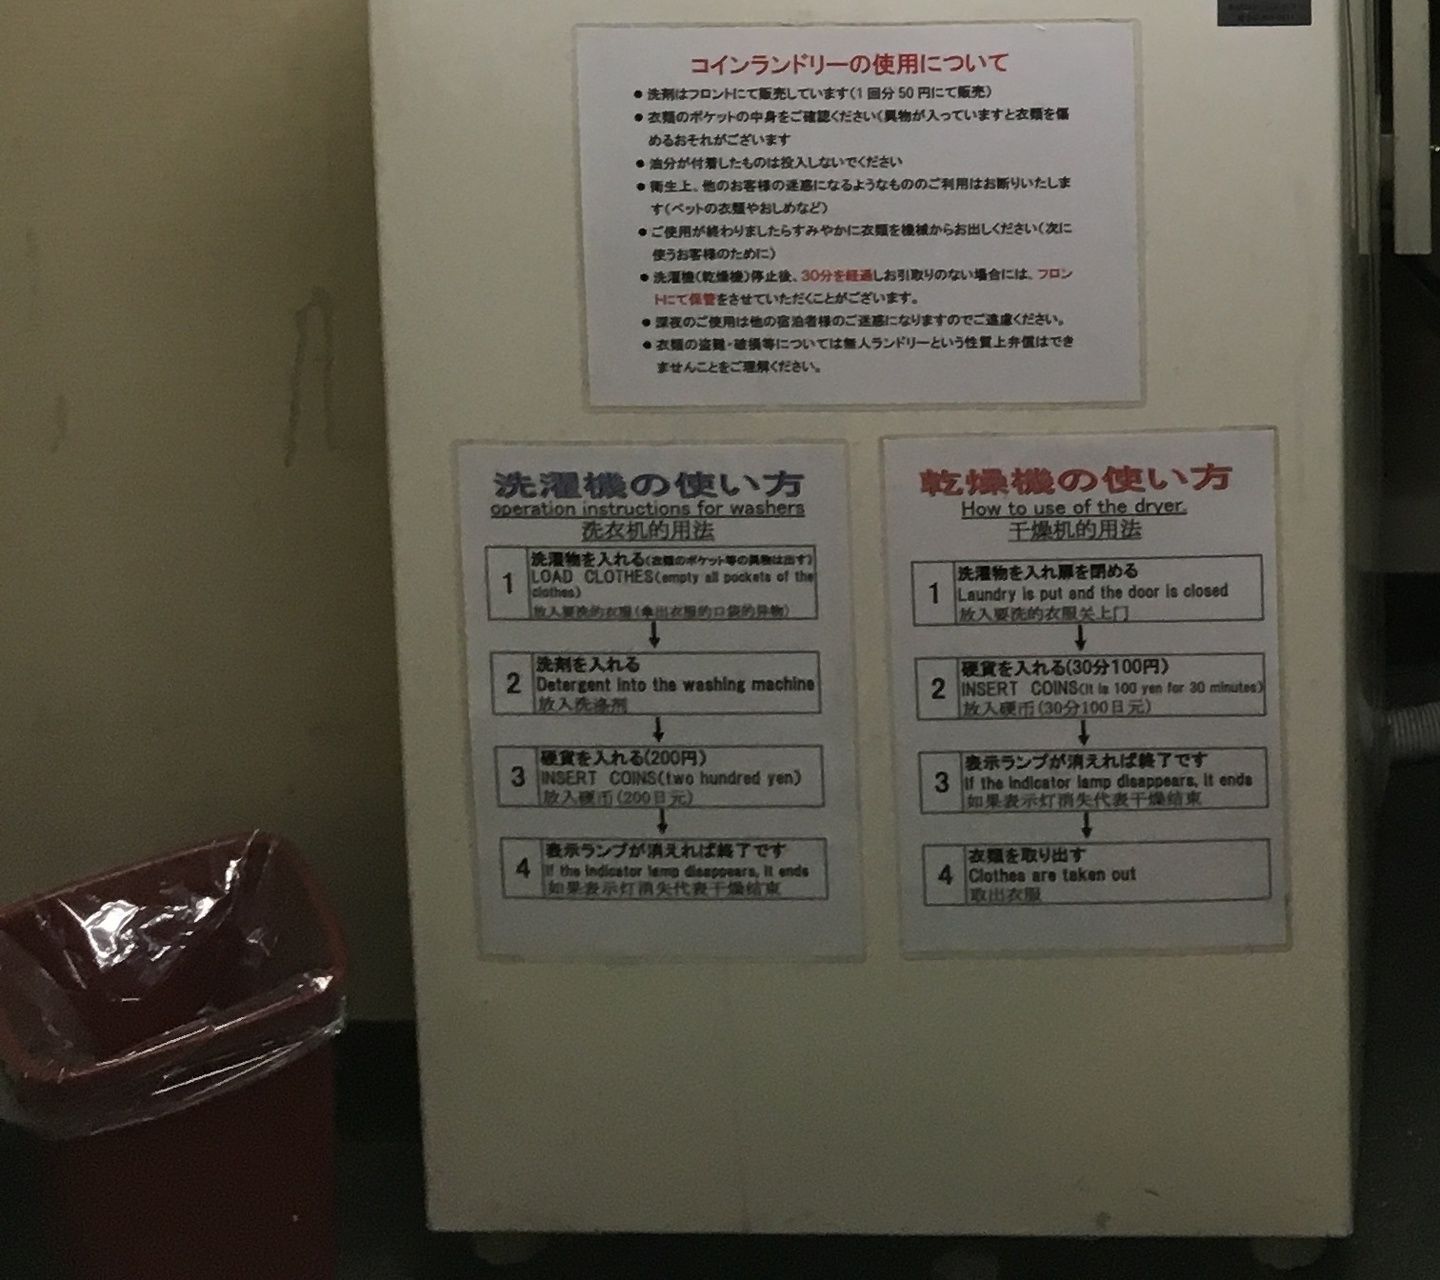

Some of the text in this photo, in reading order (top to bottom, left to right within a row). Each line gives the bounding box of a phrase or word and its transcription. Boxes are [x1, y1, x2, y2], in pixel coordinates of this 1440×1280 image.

[691, 52, 1010, 75] コインランドリーの使用について
[648, 132, 791, 148] めるおそれがございます
[649, 156, 903, 170] 油分が付着したものは投入しないでください
[493, 471, 805, 498] 洗濯機の使い方
[920, 463, 1233, 497] 乾燥機の使い方
[491, 500, 805, 518] operation instructions for washers
[962, 498, 1186, 517] How to use of the dryer.
[582, 520, 715, 541] 洗衣机的用法
[1009, 520, 1142, 540] 干燥机的用法
[503, 574, 513, 594] 1
[536, 657, 640, 673] 洗剤を入れる
[506, 672, 521, 693] 2
[536, 676, 815, 693] Detergent into the washing machine
[969, 867, 1137, 882] Clothes are taken out
